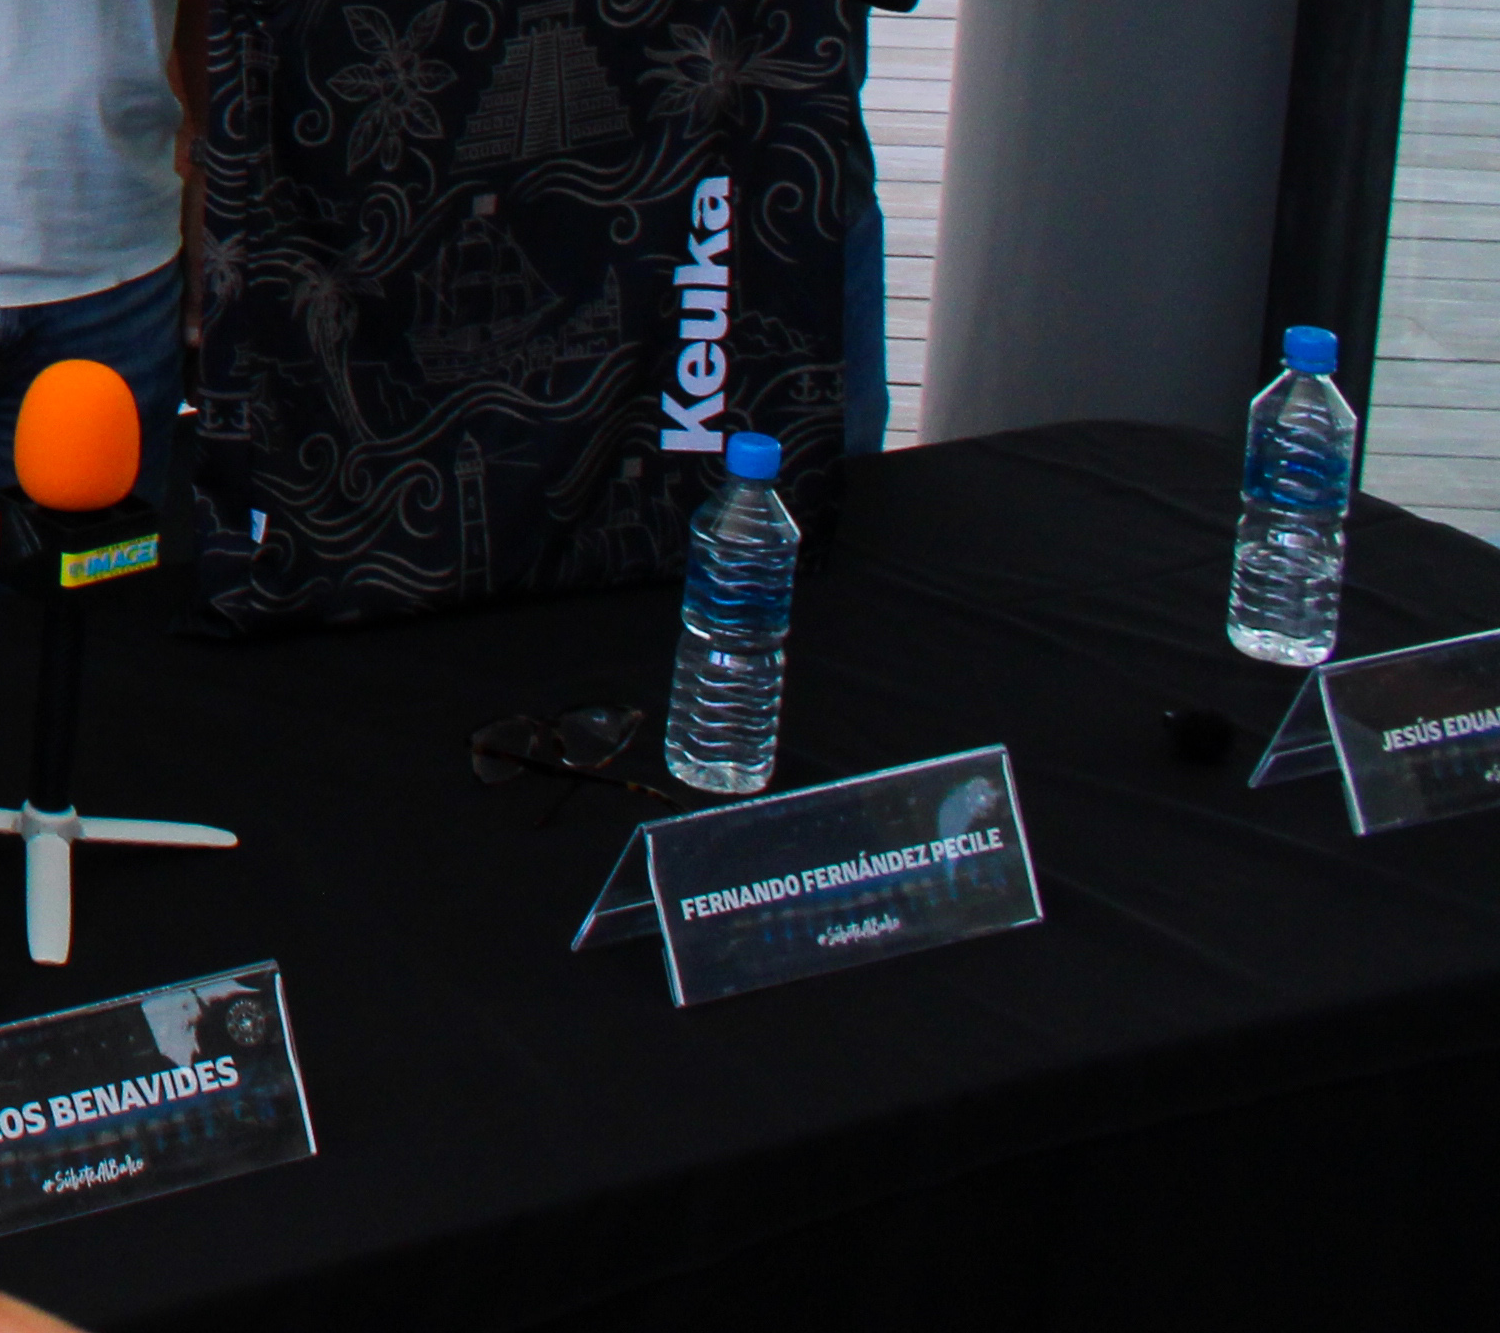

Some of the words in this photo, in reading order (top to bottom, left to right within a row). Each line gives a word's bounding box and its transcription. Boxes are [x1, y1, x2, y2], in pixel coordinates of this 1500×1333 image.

[660, 177, 730, 452] Keuka
[1382, 717, 1442, 752] JESÚS
[680, 874, 800, 921] FERNANDO
[802, 849, 931, 892] FERNÁNDEZ
[931, 828, 1004, 863] PECILE
[48, 1056, 240, 1128] BENAVIDES
